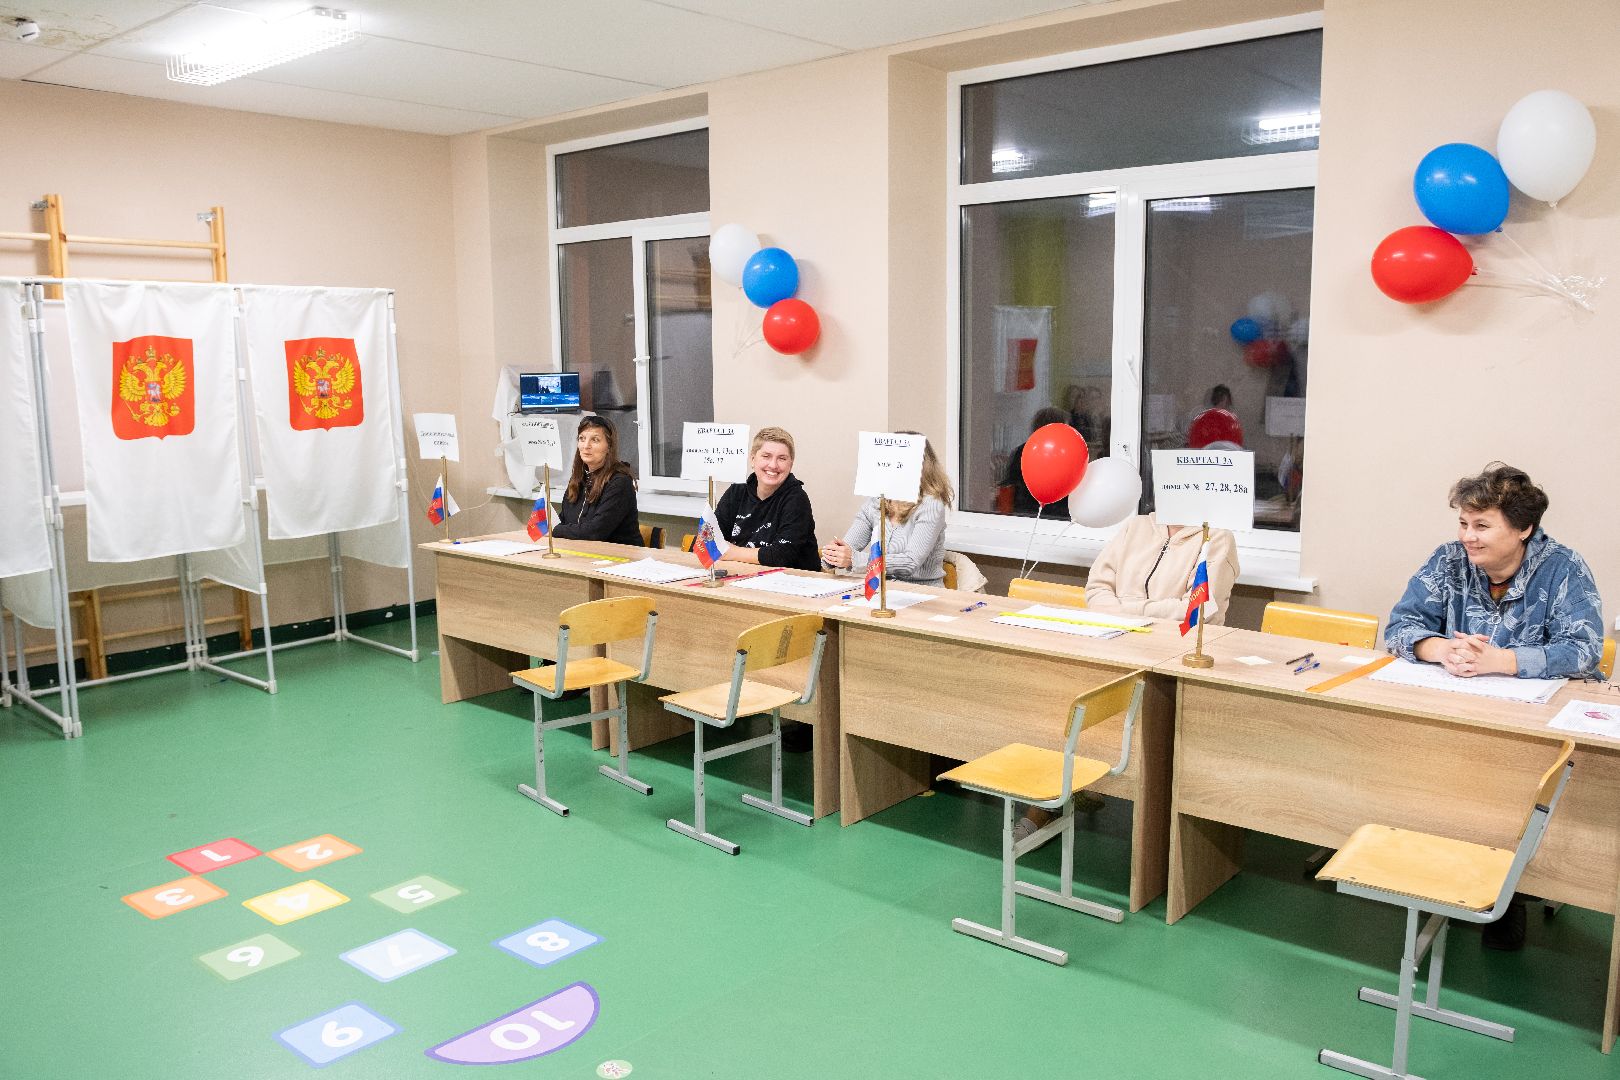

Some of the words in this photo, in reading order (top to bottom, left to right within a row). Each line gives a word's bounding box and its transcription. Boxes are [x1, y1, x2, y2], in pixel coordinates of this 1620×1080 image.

[1176, 456, 1219, 464] КВАРТАЛ
[1205, 482, 1218, 493] 27,
[1220, 483, 1232, 494] 28,
[1233, 483, 1248, 494] 28а
[200, 849, 232, 863] 1
[295, 842, 334, 861] 2
[154, 887, 195, 906] 3
[275, 892, 310, 911] 4
[397, 884, 436, 904] 5
[525, 931, 570, 952] 8
[386, 944, 424, 968] 7
[490, 1010, 576, 1051] 10
